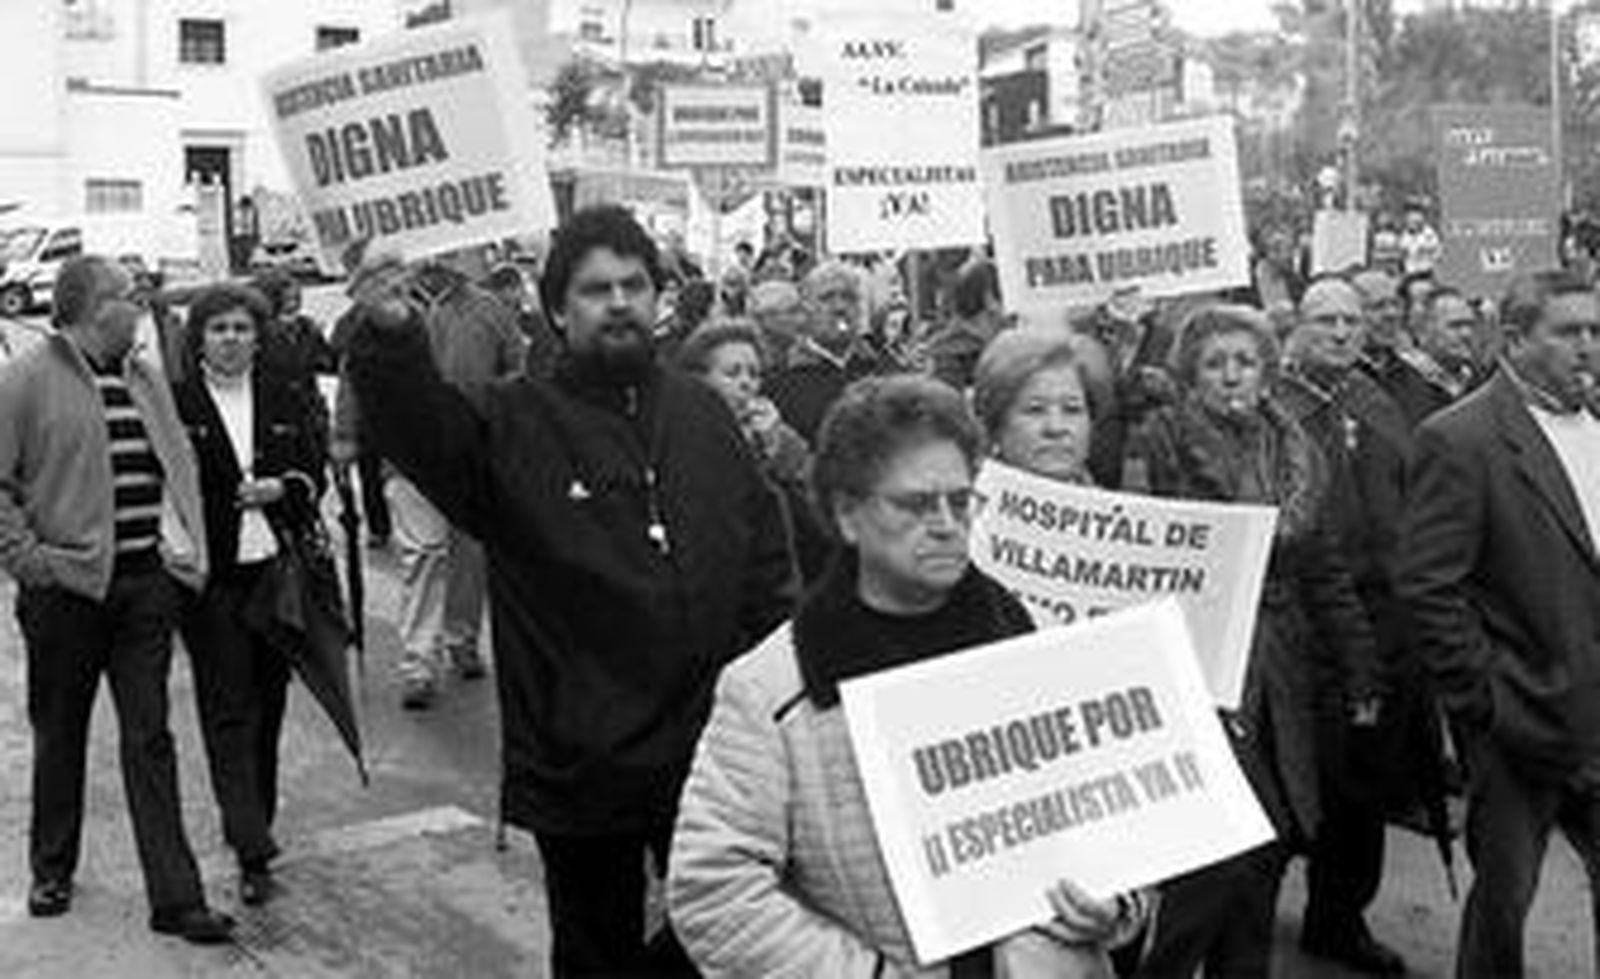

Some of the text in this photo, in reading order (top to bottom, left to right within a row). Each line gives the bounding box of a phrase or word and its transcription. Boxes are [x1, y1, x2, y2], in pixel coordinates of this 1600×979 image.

[305, 106, 449, 187] DIGNA
[351, 171, 510, 237] UBRIQUE
[1048, 182, 1178, 239] DIGNA
[1025, 236, 1218, 288] PARA UBRIQUE
[989, 534, 1205, 593] VILLAMARTIN
[1164, 521, 1211, 550] DE
[912, 685, 1162, 796] UBRIQUE POR
[947, 769, 1139, 864] ESPECIALISTA
[1131, 757, 1179, 803] YA
